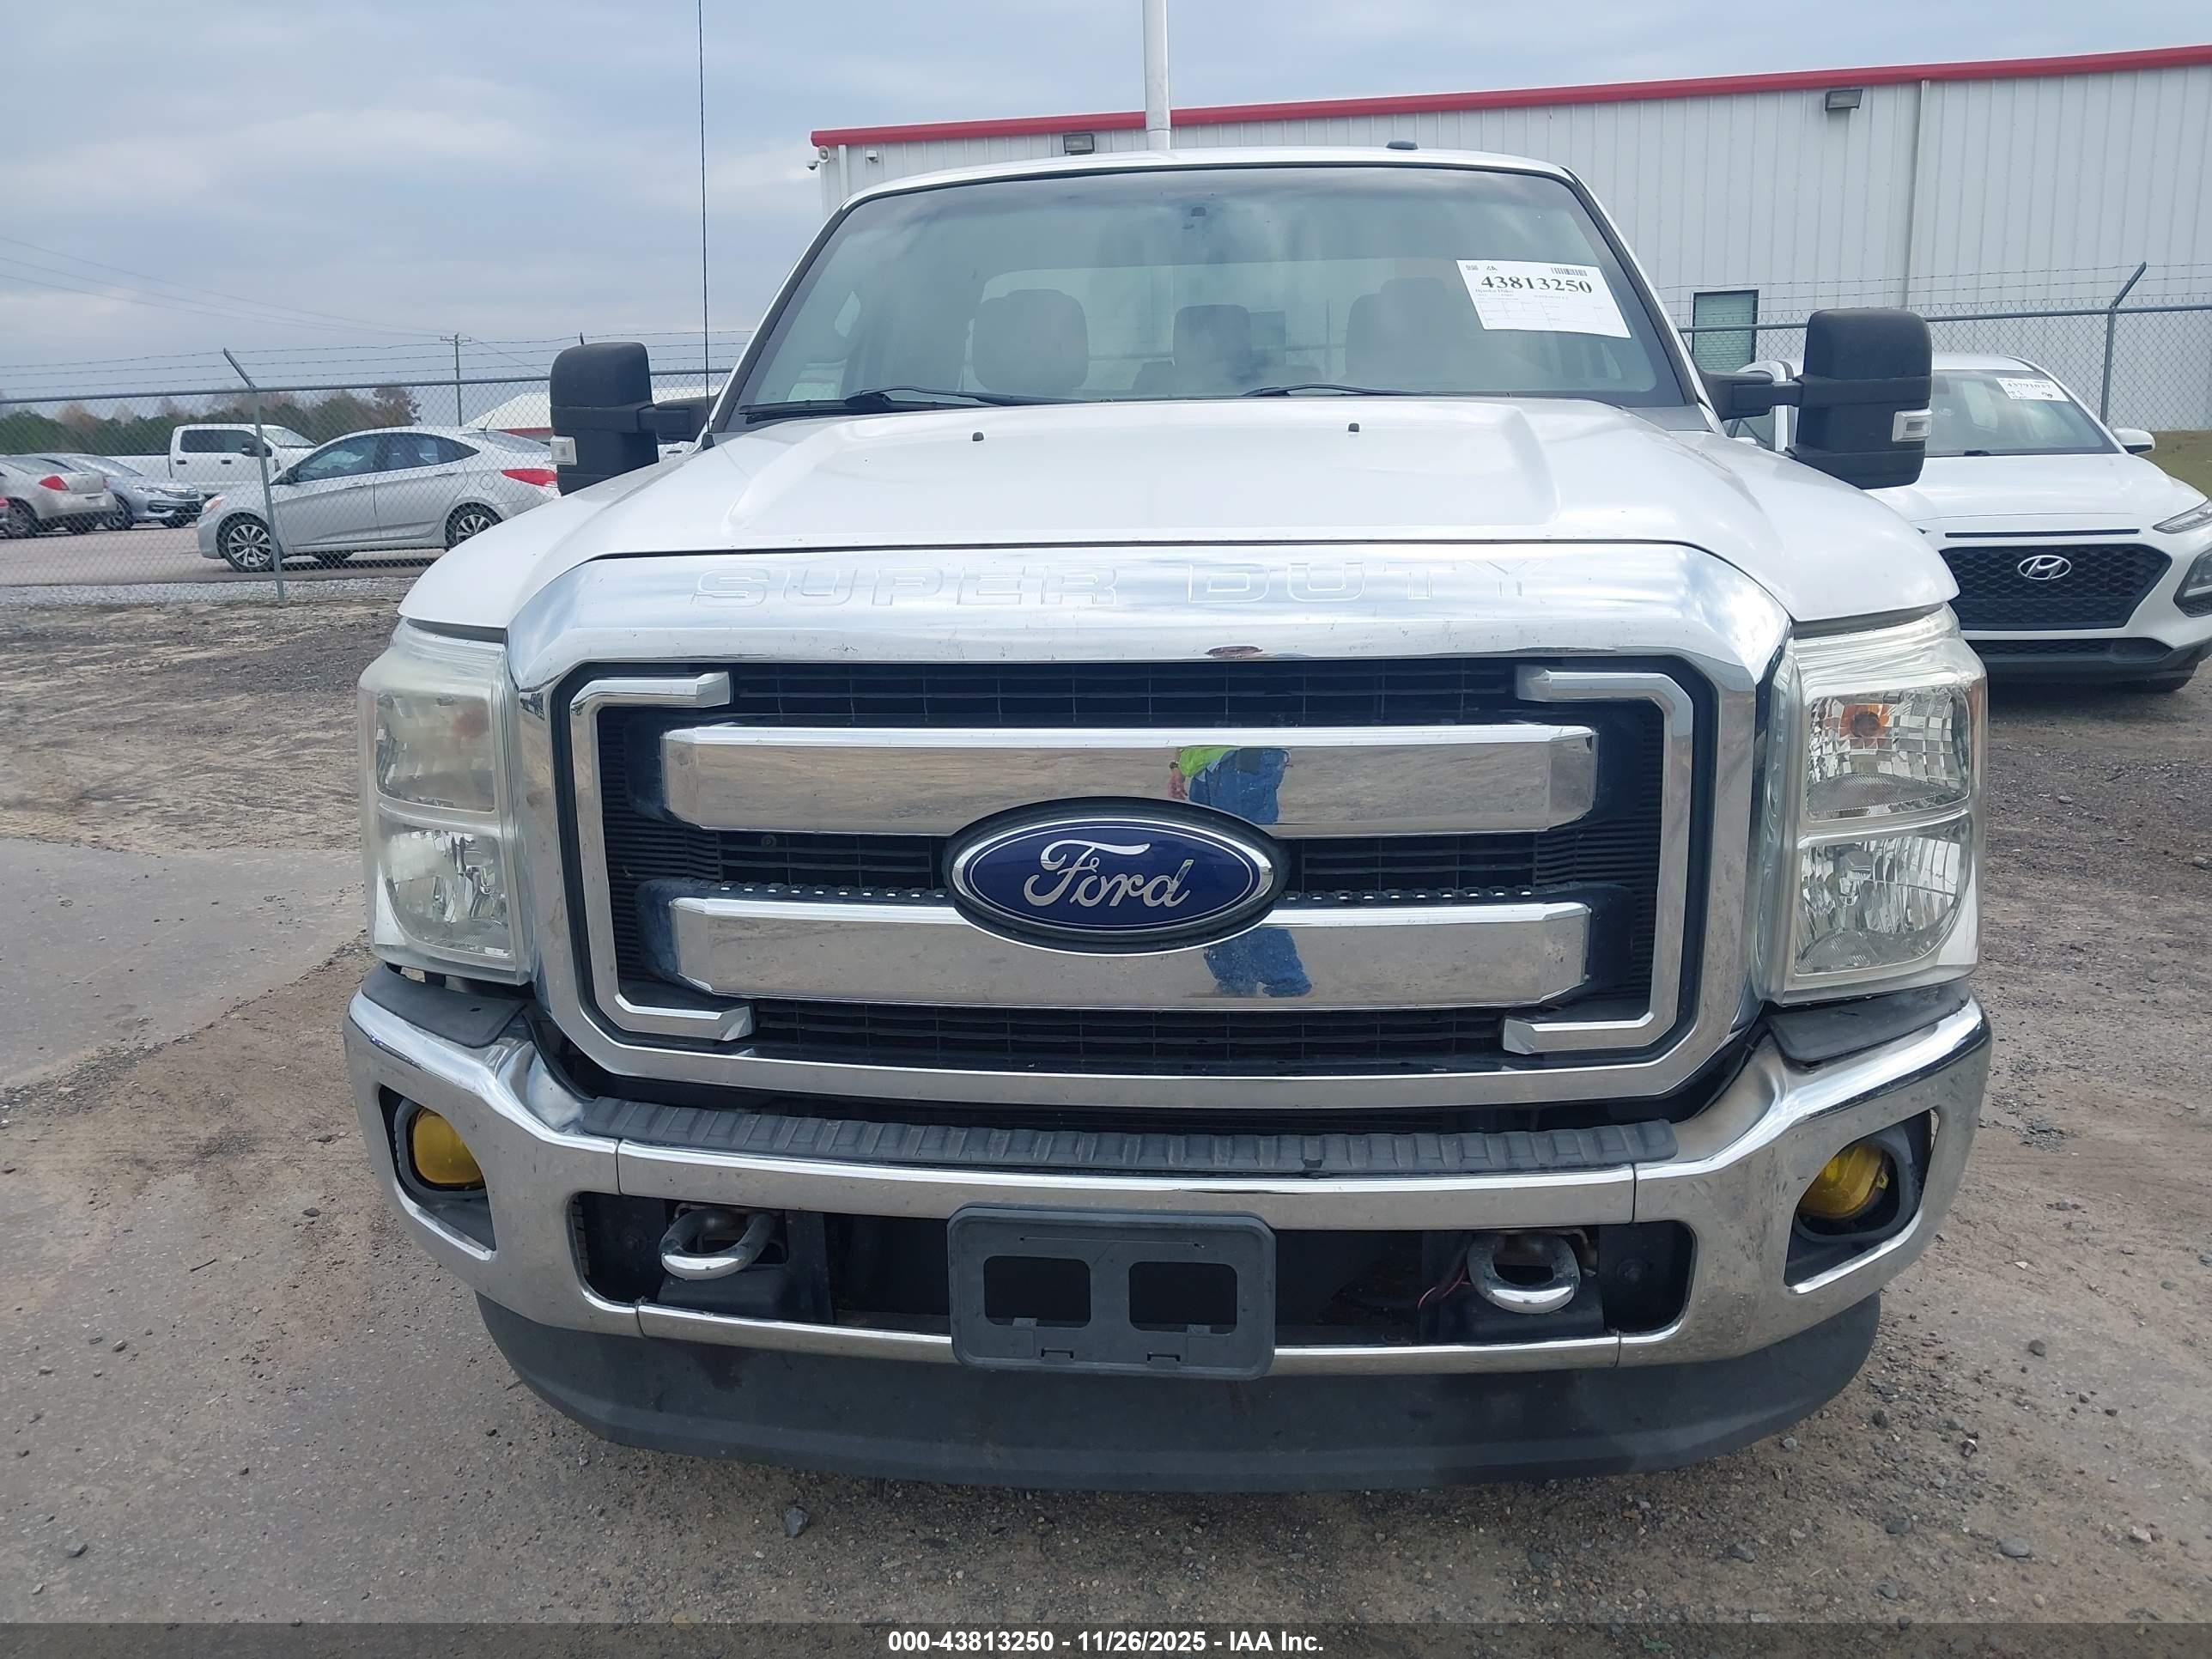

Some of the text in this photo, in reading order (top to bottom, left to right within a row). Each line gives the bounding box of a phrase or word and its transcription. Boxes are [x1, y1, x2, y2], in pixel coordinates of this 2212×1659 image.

[1480, 276, 1593, 294] 43813250
[690, 560, 1552, 607] SUPER DUTY
[1023, 839, 1194, 908] Ford
